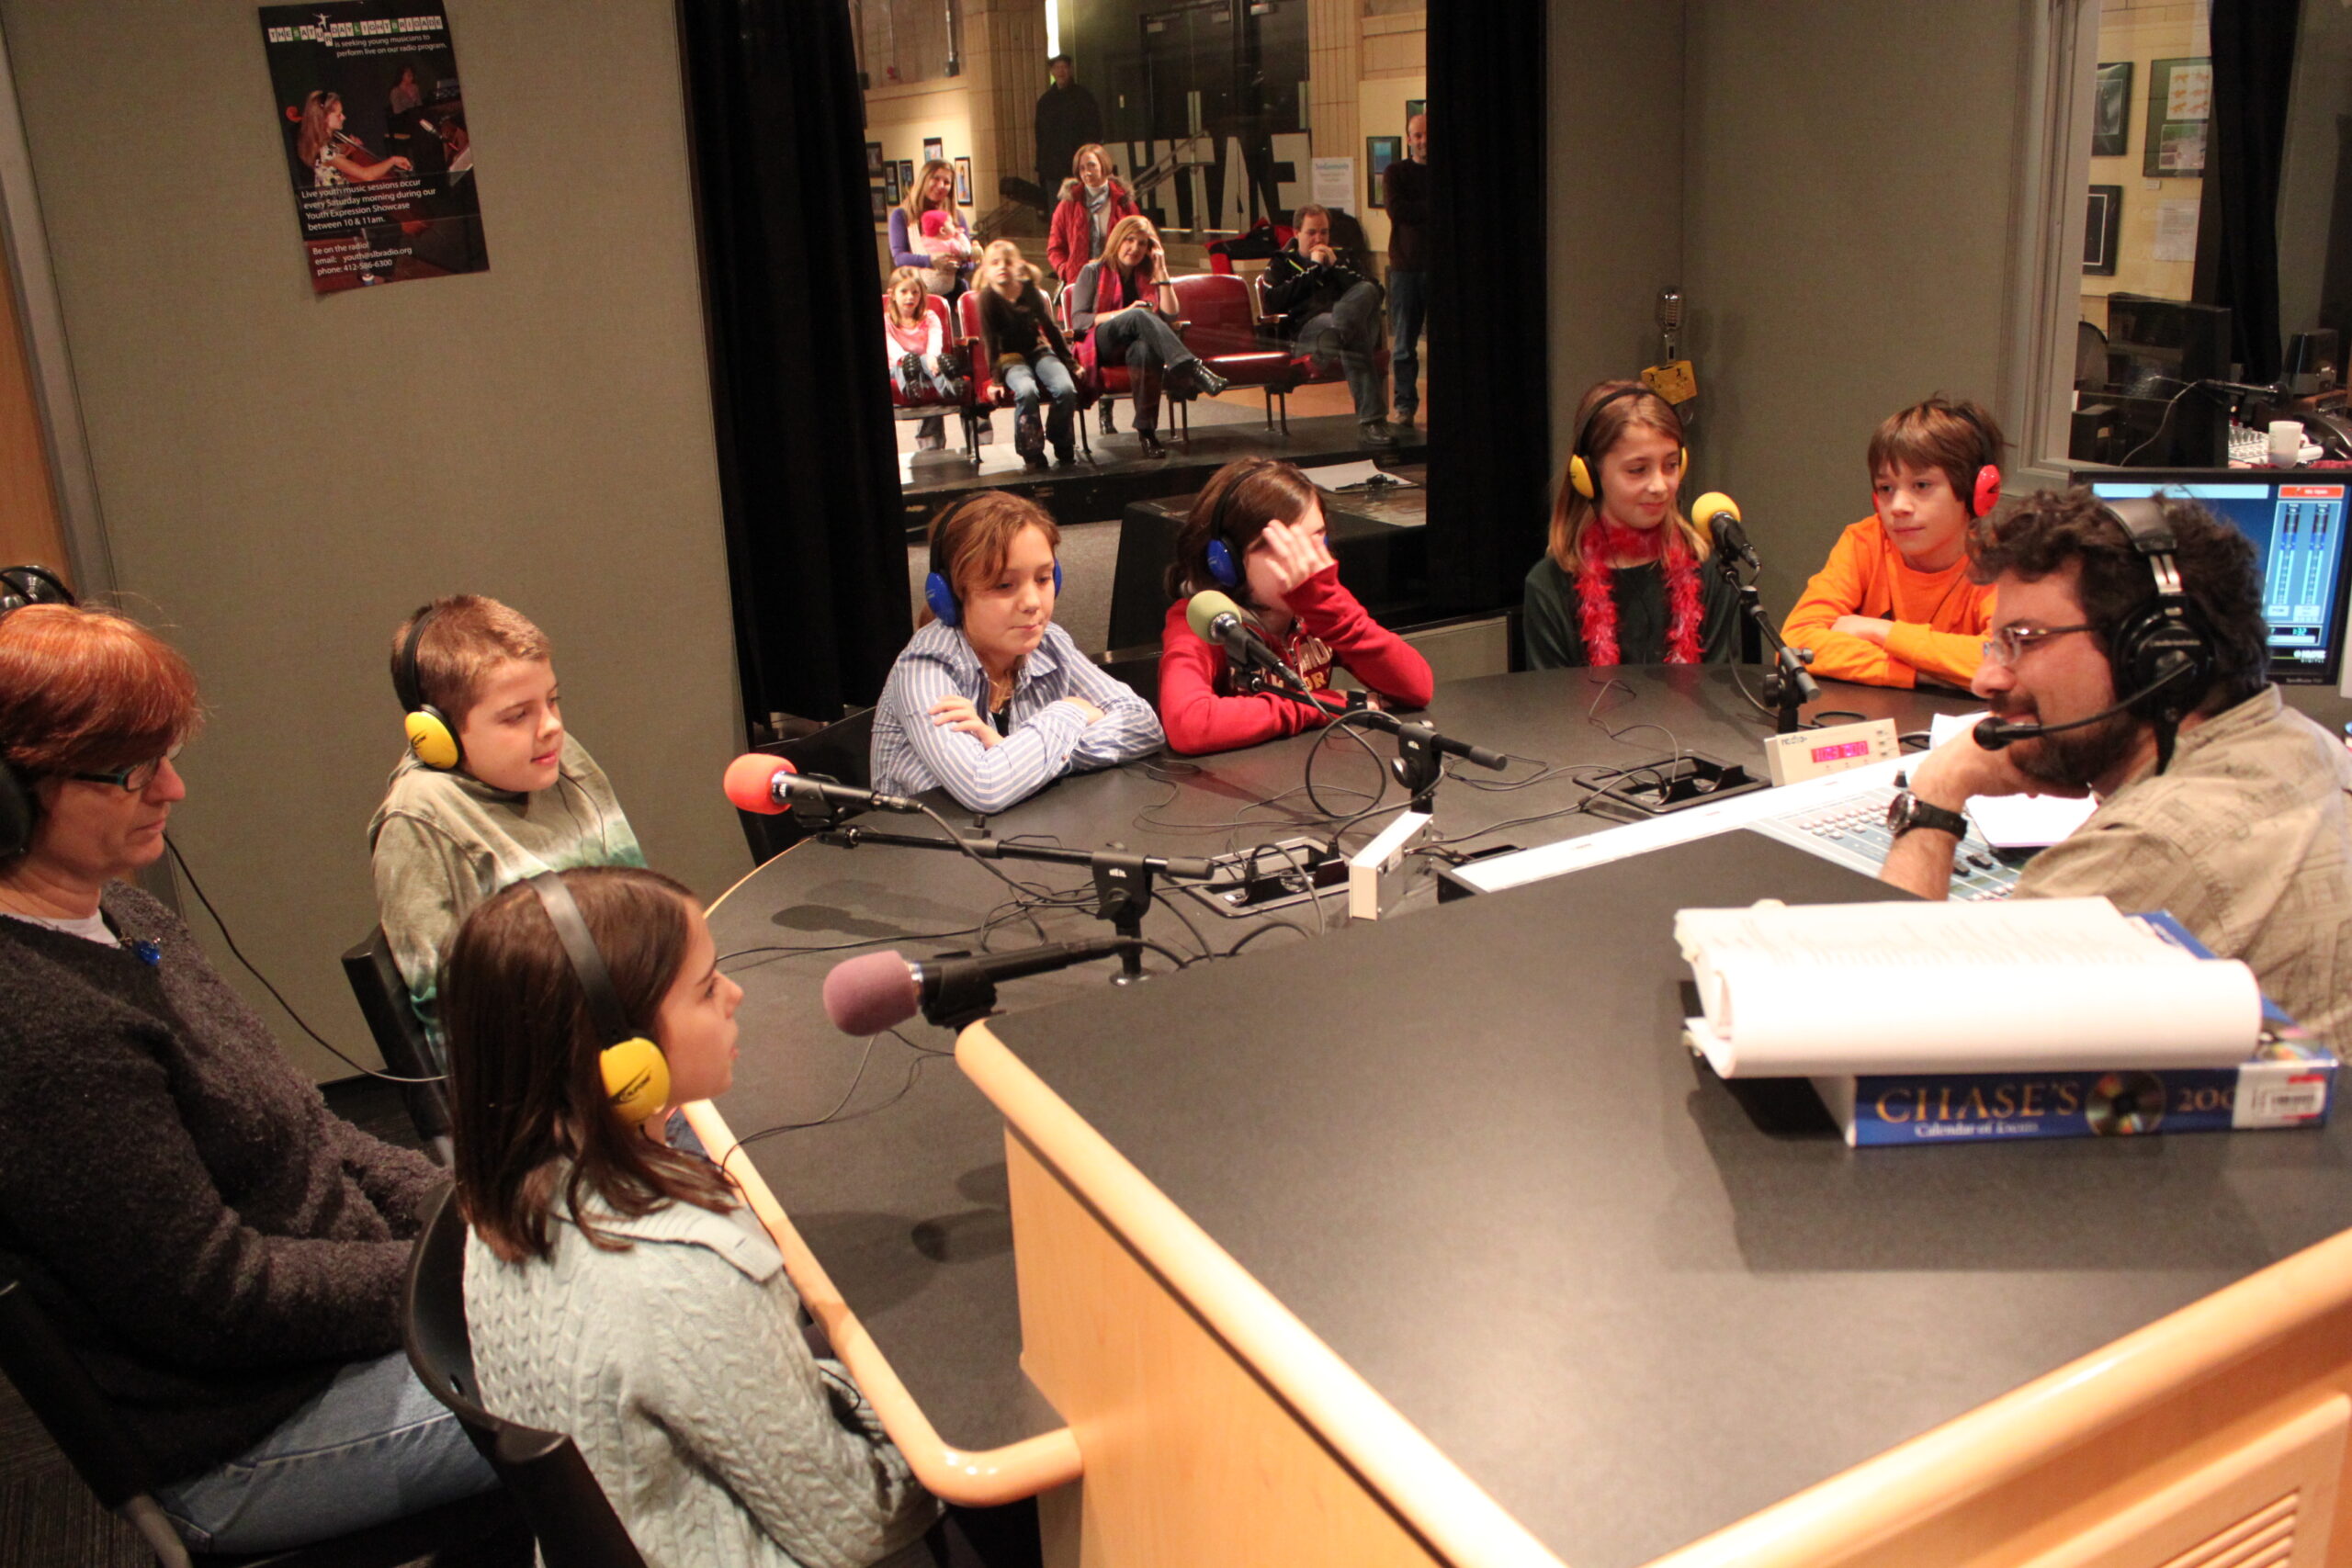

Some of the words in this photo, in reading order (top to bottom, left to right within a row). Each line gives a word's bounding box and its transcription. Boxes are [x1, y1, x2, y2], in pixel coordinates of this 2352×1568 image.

[336, 49, 364, 58] perform
[417, 42, 447, 51] program.
[341, 39, 367, 47] seeking
[368, 38, 389, 46] young
[319, 187, 343, 197] youth
[368, 182, 399, 191] sessions
[400, 179, 421, 187] occur
[304, 201, 325, 209] every
[326, 197, 360, 207] Saturday
[362, 193, 395, 201] morning
[396, 189, 422, 198] during
[305, 211, 329, 220] Youth
[330, 207, 371, 218] Expression
[372, 202, 410, 213] Showcase
[308, 221, 342, 231] between
[362, 216, 385, 224] 11am.
[312, 247, 322, 255] Be
[334, 244, 347, 253] the
[348, 242, 368, 251] radio!
[315, 255, 336, 265] email:
[317, 266, 343, 276] phone:
[1875, 1082, 2079, 1123] CHASE'S
[1914, 1122, 1974, 1138] Calendar
[1975, 1121, 1992, 1134] of
